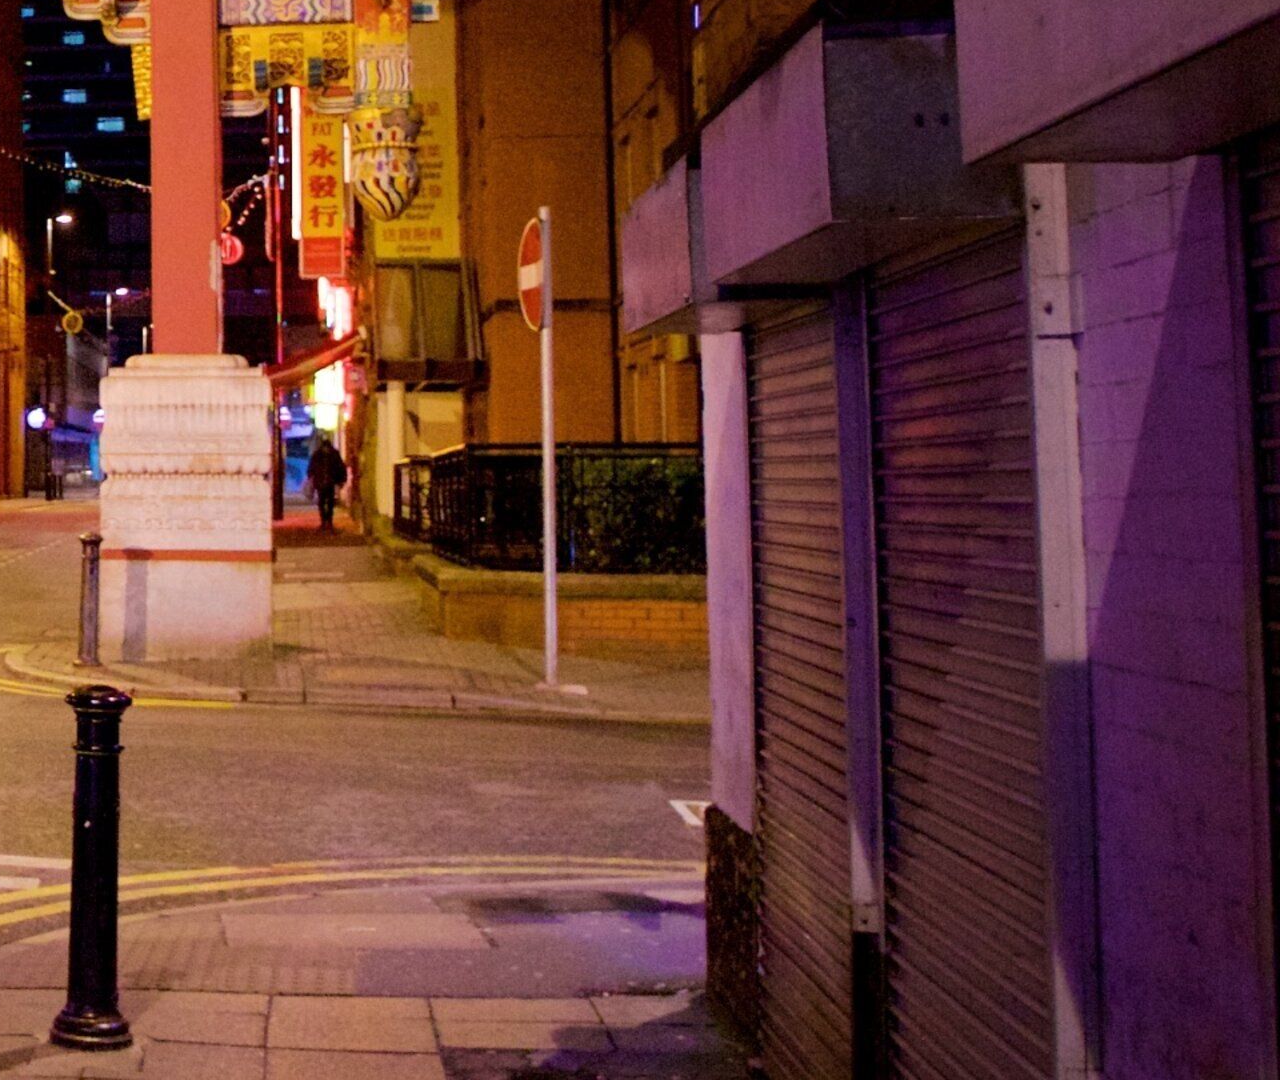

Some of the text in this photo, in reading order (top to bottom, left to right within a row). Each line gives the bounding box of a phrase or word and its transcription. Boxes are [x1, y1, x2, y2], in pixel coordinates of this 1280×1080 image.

[312, 122, 333, 136] FAT
[308, 144, 338, 228] 永發行
